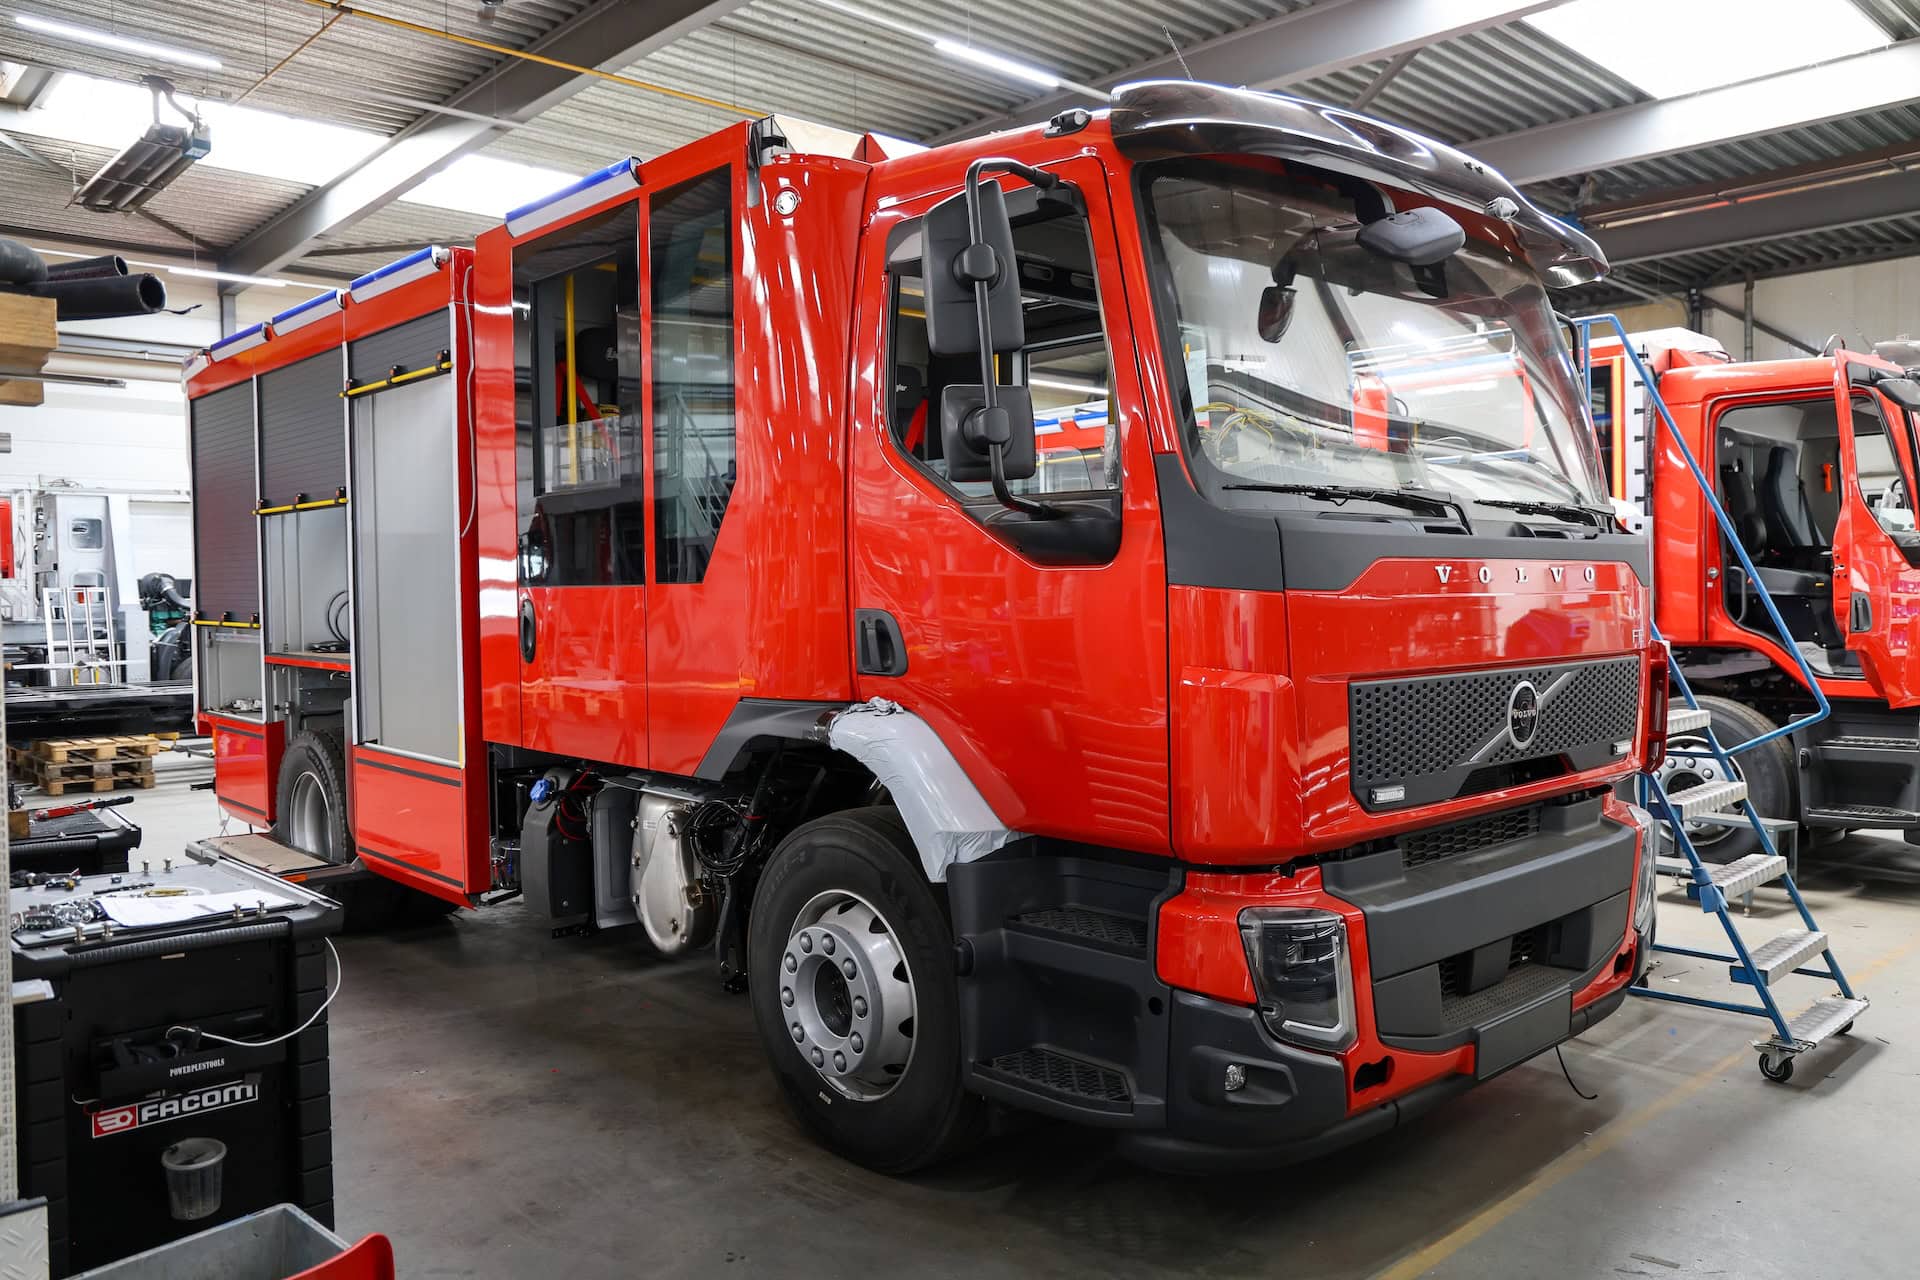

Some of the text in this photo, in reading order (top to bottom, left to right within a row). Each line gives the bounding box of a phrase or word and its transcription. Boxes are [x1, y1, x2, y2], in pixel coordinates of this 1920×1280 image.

[1435, 566, 1595, 583] VOLVO
[1512, 709, 1537, 719] VOLVO
[141, 1084, 254, 1122] FACOM
